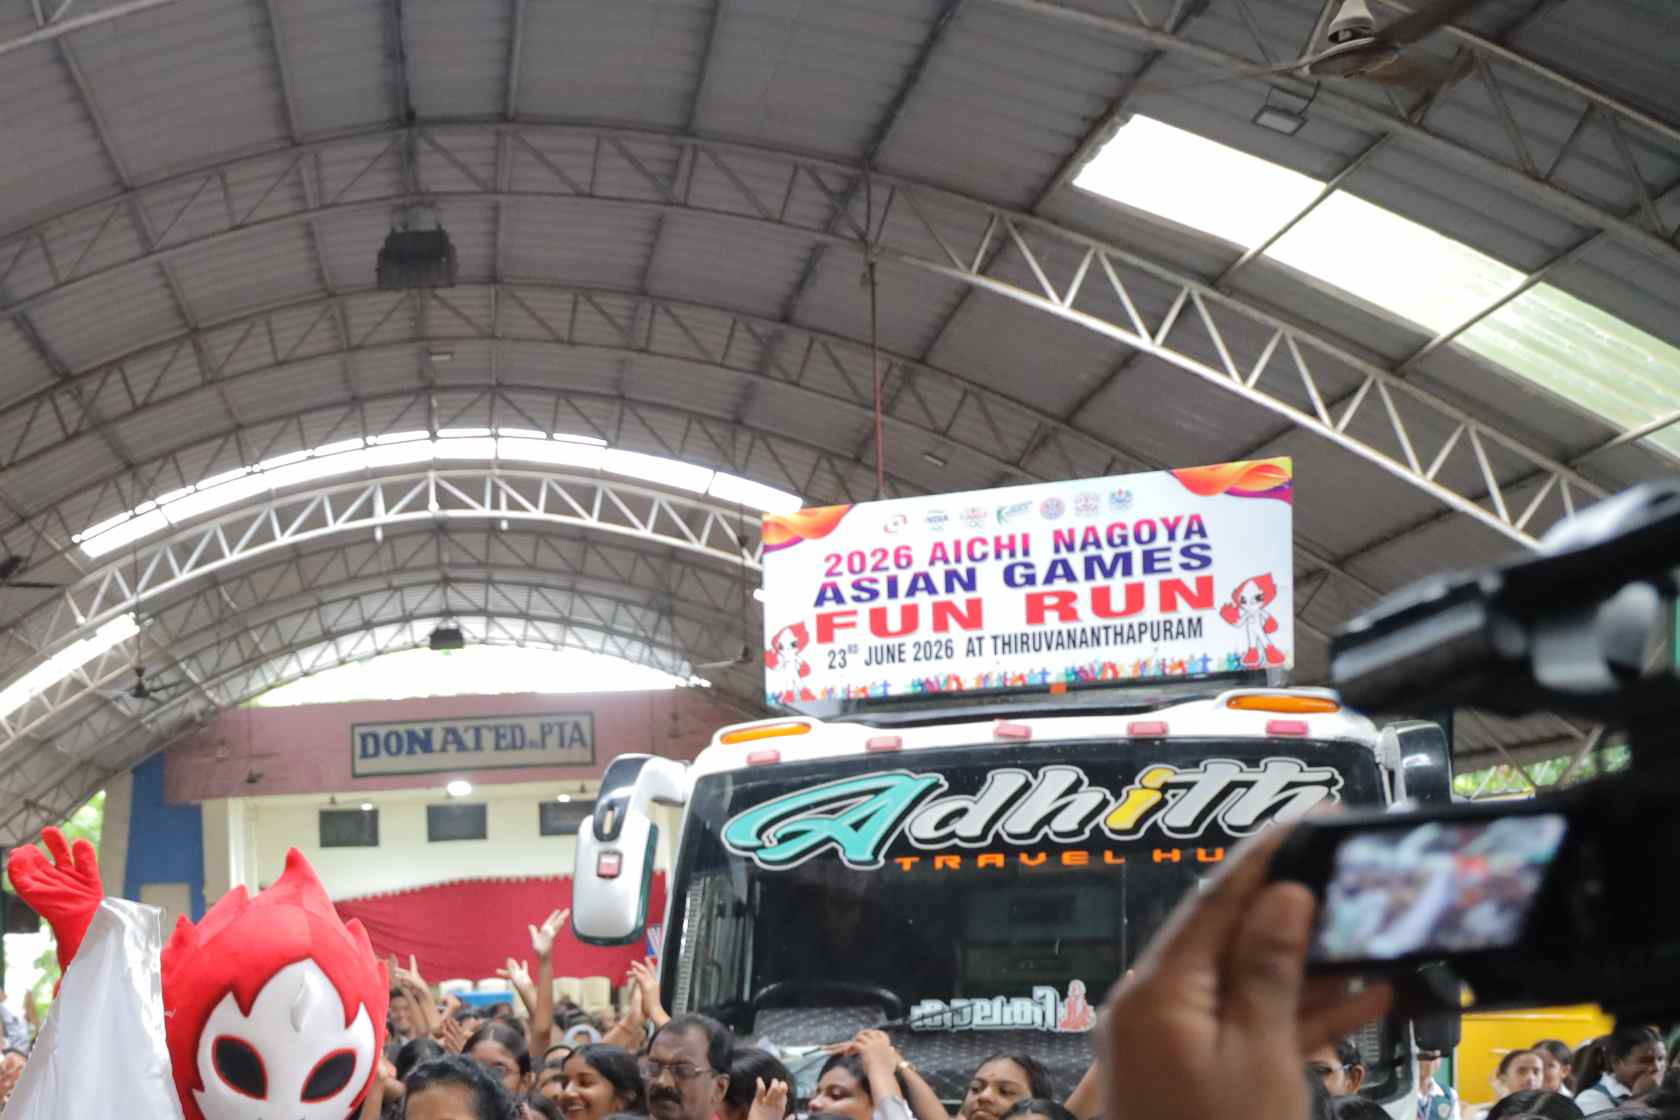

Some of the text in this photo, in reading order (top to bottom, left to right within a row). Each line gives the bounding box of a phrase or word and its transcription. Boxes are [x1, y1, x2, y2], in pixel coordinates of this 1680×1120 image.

[824, 513, 1209, 578] 2026 AICHI NAGOYA
[814, 543, 1214, 608] ASIAN GAMES
[816, 575, 1216, 645] FUN RUN
[864, 644, 907, 667] JUNE
[913, 638, 955, 661] 2026
[965, 635, 986, 658] AT
[991, 617, 1204, 656] THIRUVANANTHAPURAM
[359, 721, 588, 759] DONATED PTA
[895, 847, 1226, 872] TRAVEL HU
